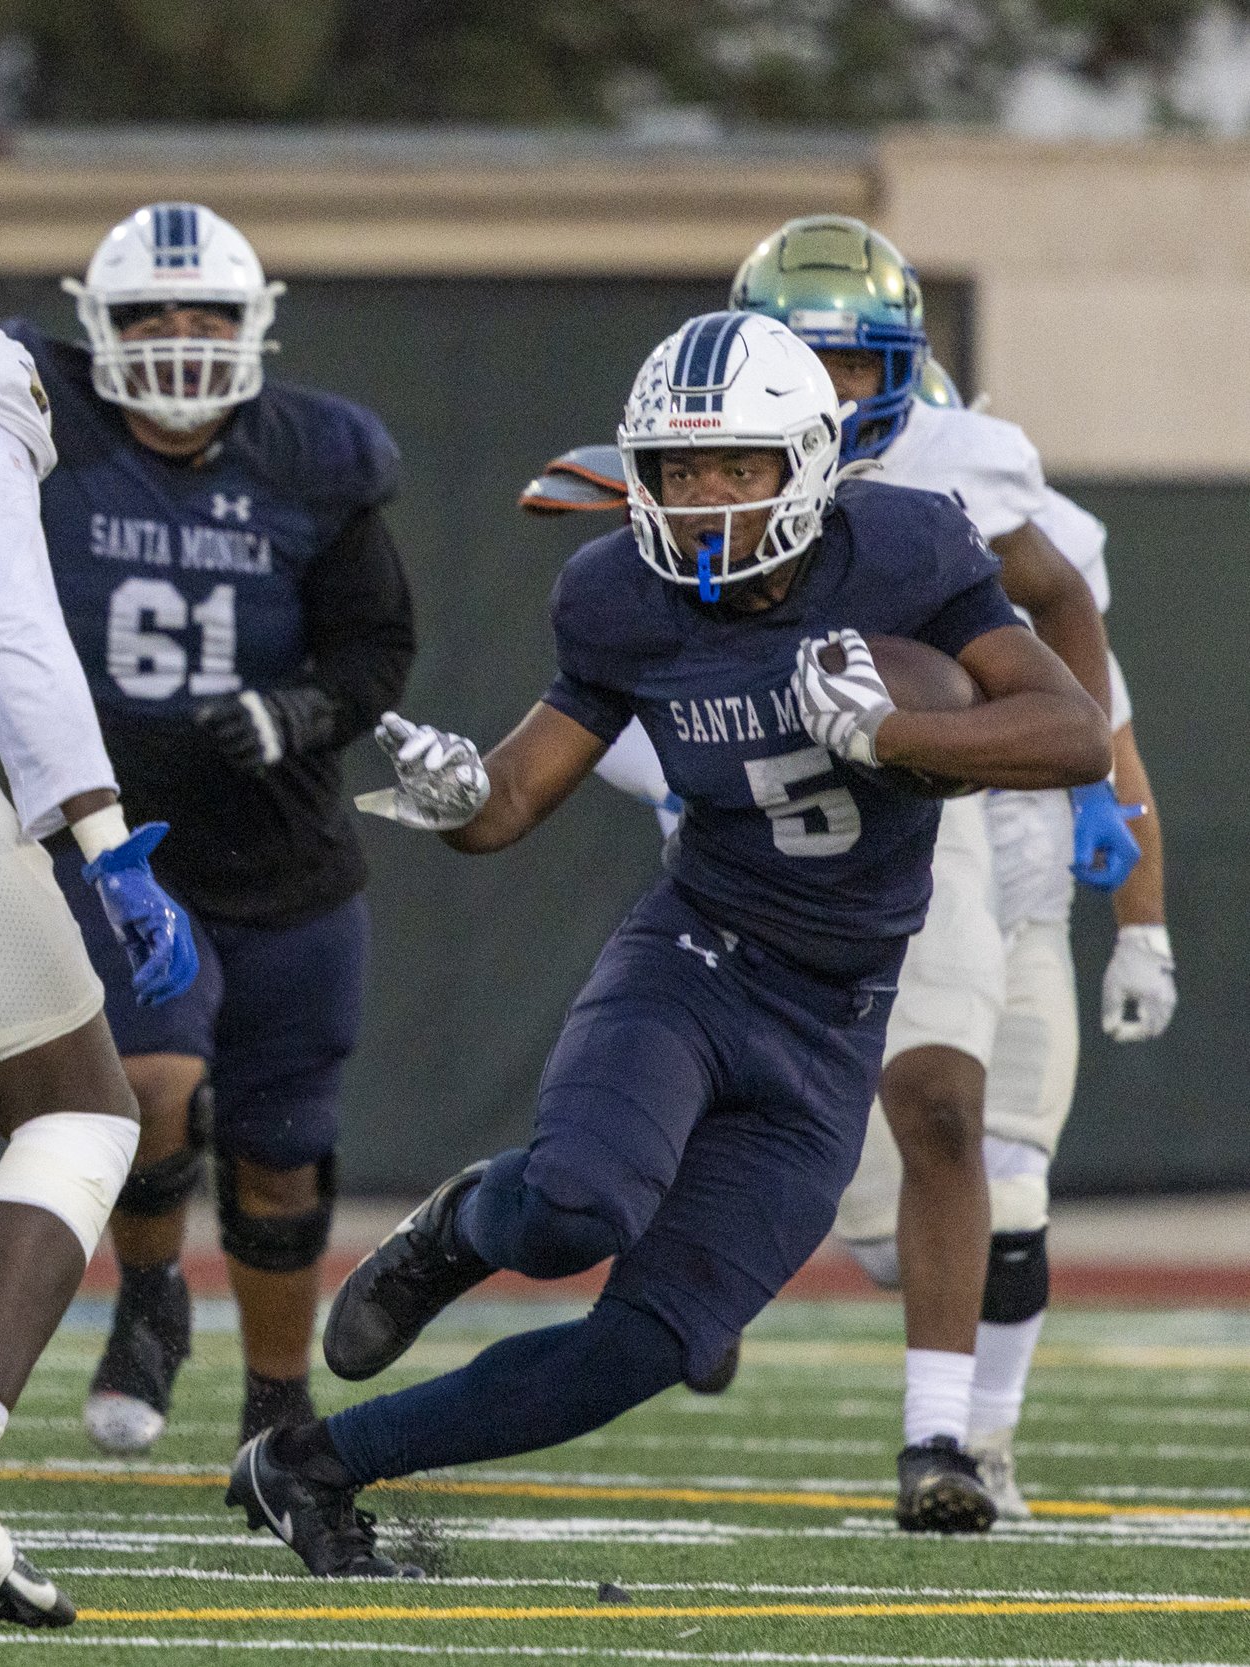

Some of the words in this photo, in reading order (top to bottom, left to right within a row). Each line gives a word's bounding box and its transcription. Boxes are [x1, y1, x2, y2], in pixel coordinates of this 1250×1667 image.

[106, 577, 242, 700] 61
[669, 695, 766, 743] SANTA
[743, 745, 862, 857] 5
